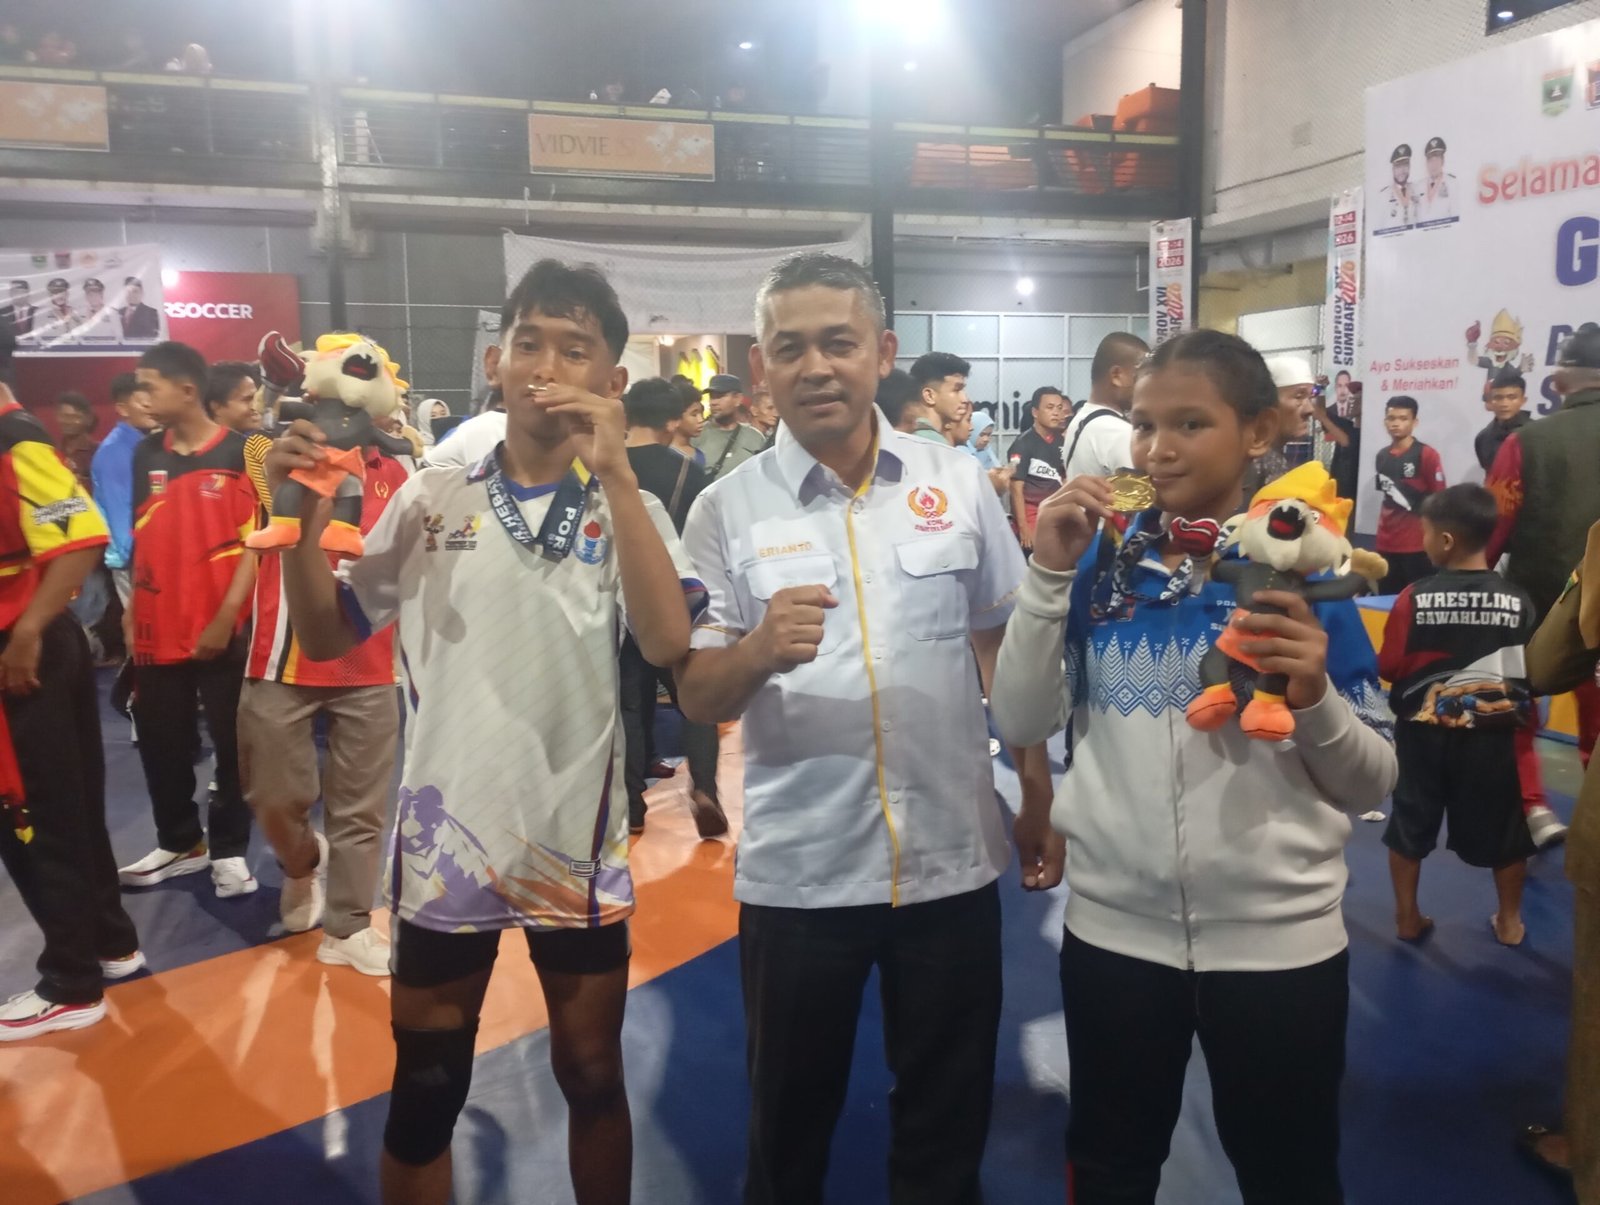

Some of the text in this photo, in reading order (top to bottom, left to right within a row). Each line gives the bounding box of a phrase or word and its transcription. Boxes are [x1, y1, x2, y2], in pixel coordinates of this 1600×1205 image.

[1343, 302, 1355, 366] SUMBAR
[1369, 356, 1459, 375] Ayo Sukseskan
[1392, 376, 1459, 391] Meriahkan!
[1415, 592, 1521, 612] WRESTLING
[1416, 611, 1520, 628] SAWAHLUNTO
